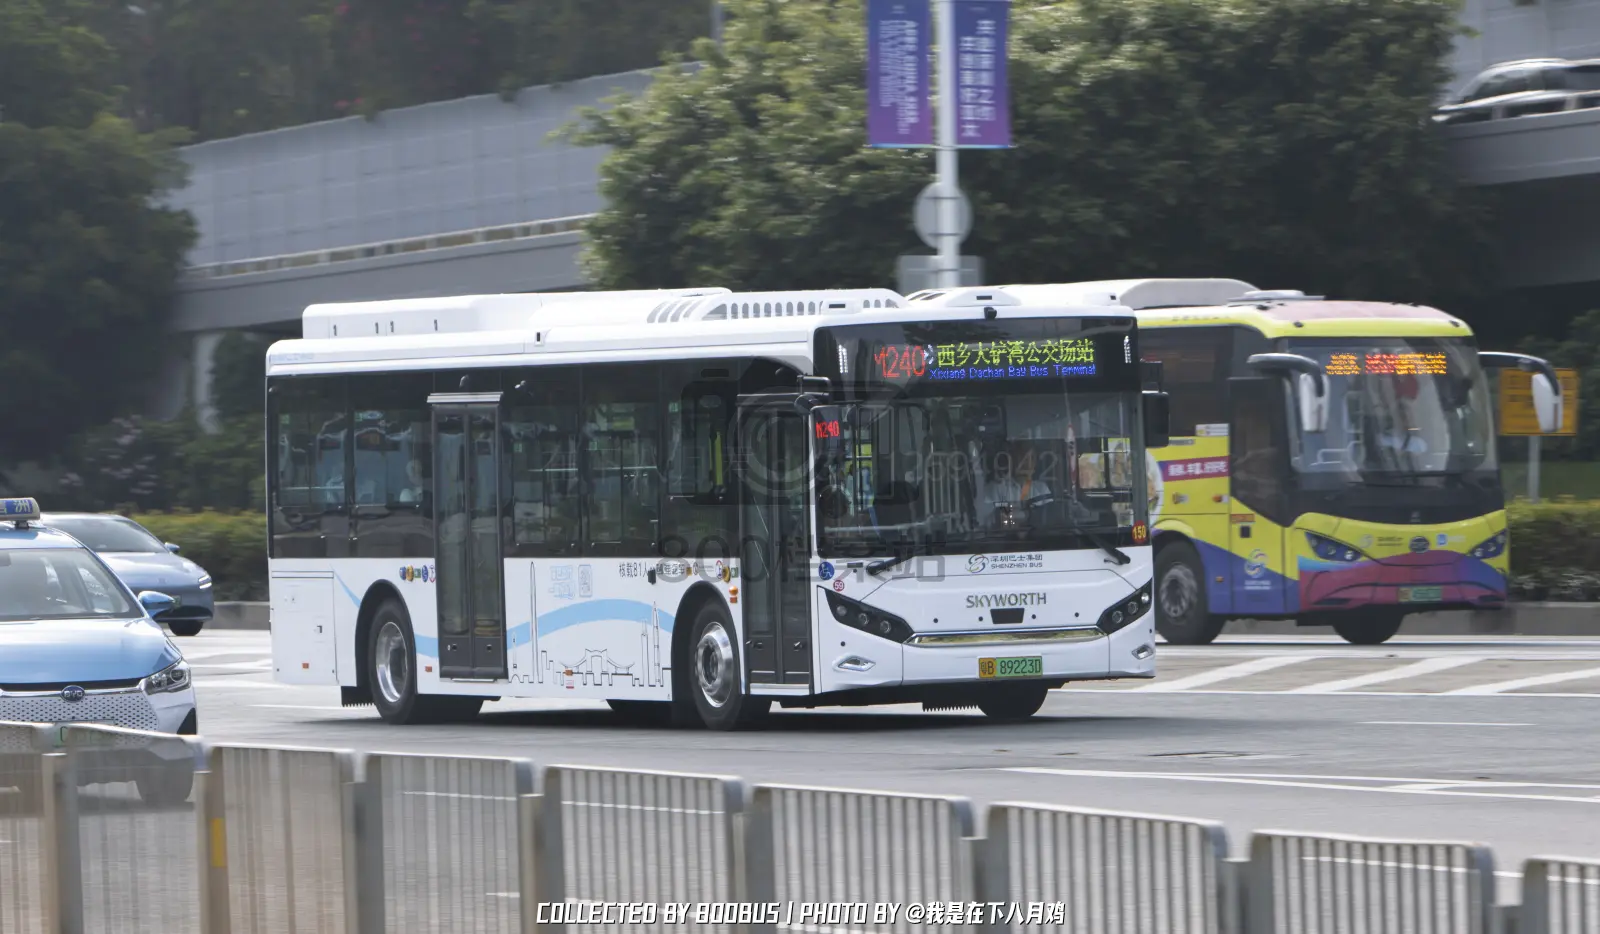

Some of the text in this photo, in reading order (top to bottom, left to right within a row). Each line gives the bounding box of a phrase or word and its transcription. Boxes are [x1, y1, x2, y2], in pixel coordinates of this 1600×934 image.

[937, 339, 1095, 367] 西乡大铲湾公交场站
[929, 363, 1097, 379] Xixiang Dachan Bay Bus Terminal
[1133, 525, 1147, 540] 150
[991, 554, 1043, 562] 深圳巴士集团
[966, 592, 1047, 608] SKYWORTH
[999, 659, 1041, 675] 89223D
